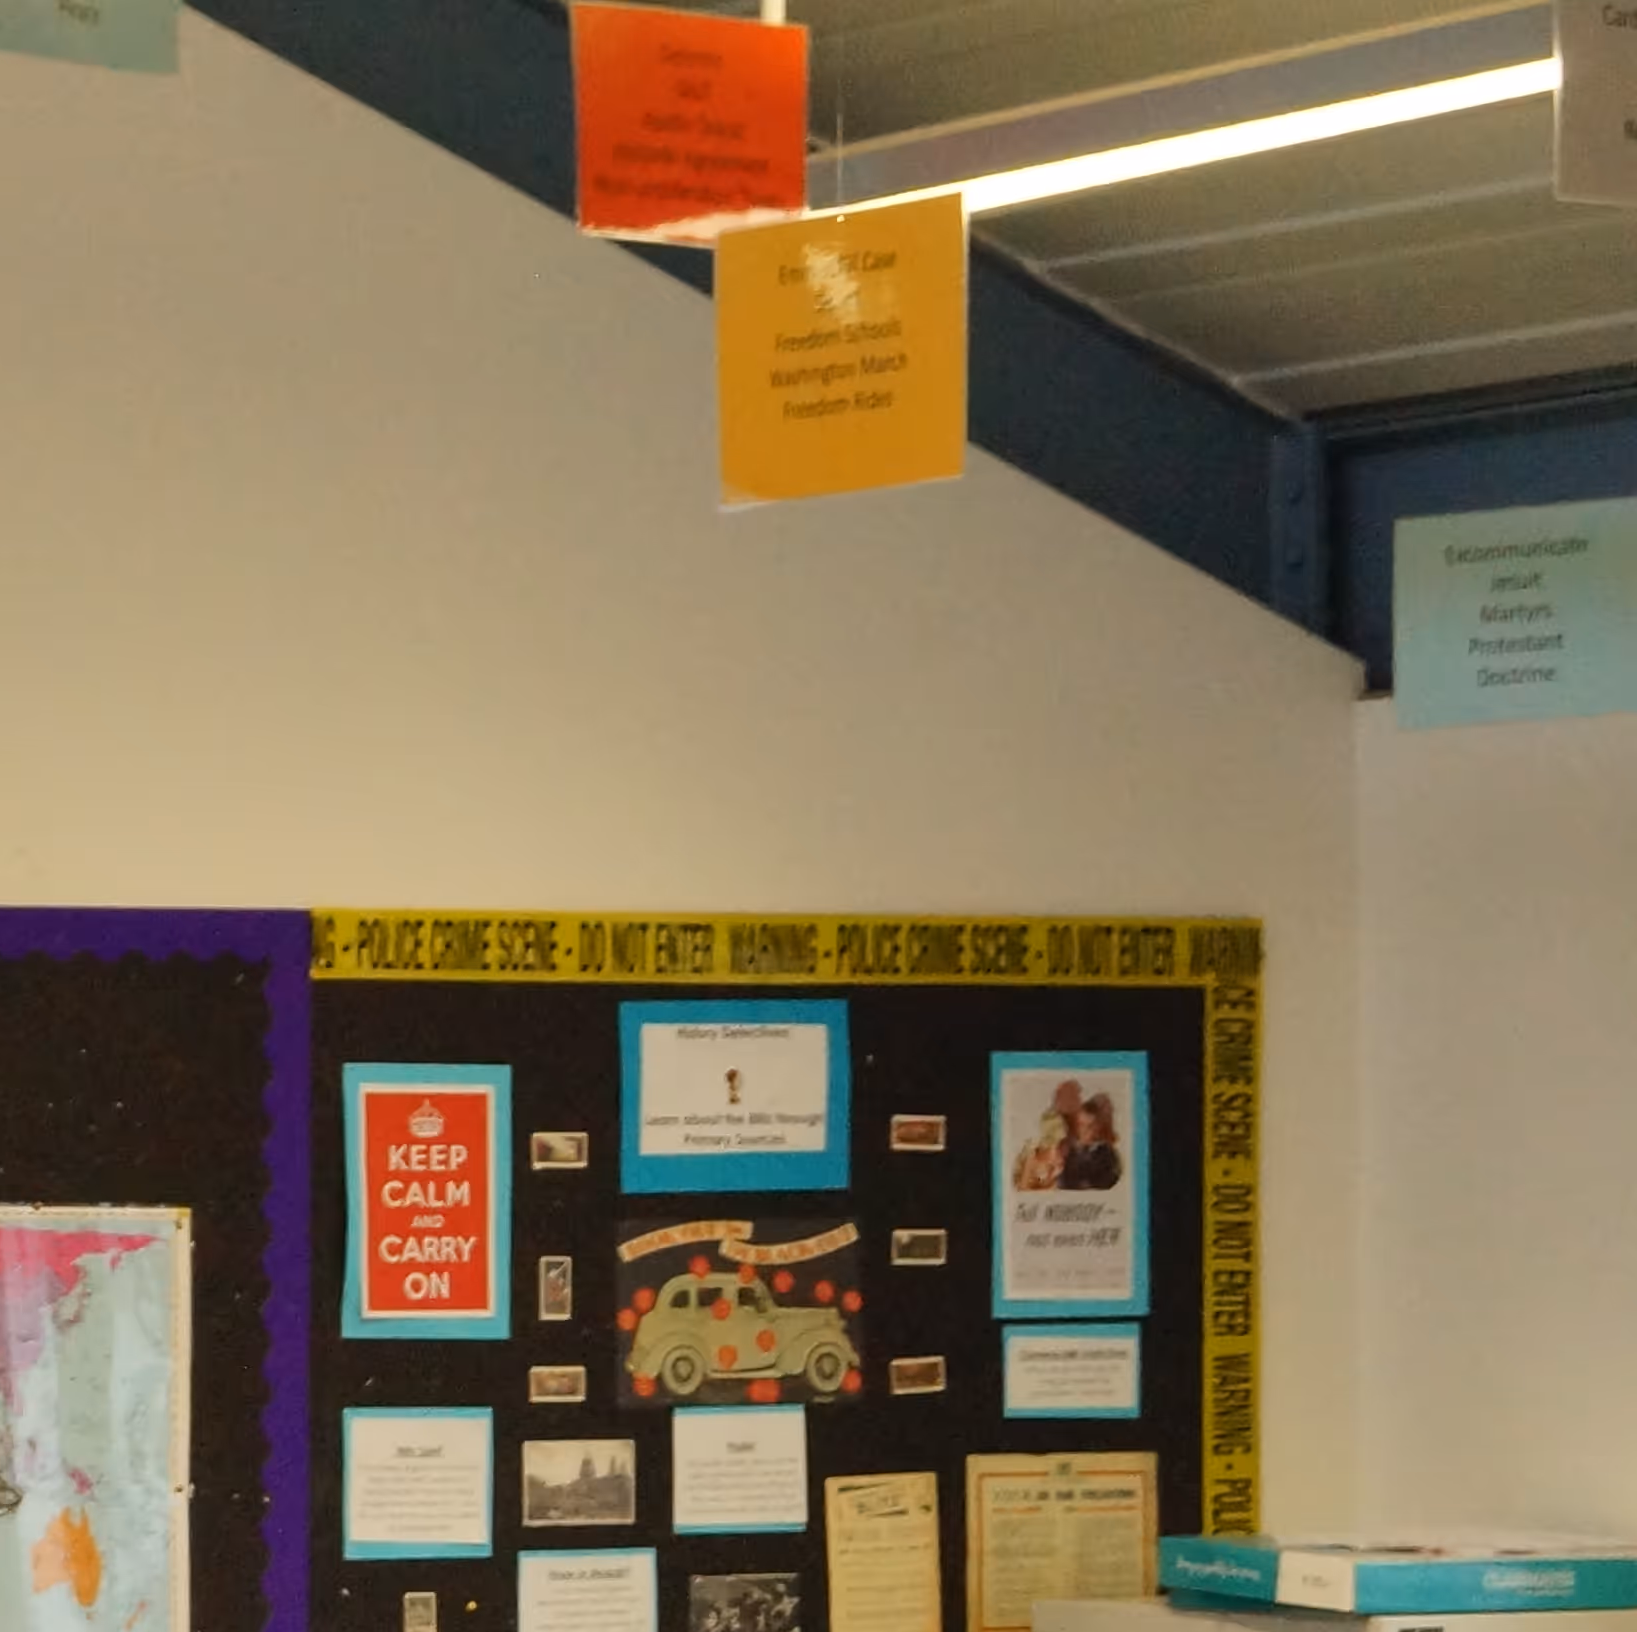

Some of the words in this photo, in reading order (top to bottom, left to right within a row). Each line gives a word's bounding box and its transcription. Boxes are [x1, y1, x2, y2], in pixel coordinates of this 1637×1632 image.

[774, 325, 841, 352] Freedom
[770, 360, 856, 389] Washington
[860, 353, 908, 376] March
[783, 394, 849, 420] Freedom
[1211, 1017, 1256, 1086] CRIME
[1211, 1092, 1256, 1160] SCENE
[387, 1143, 468, 1172] KEEP
[381, 1180, 470, 1209] CALM
[1211, 1183, 1256, 1214] DO
[410, 1213, 445, 1229] AND
[379, 1234, 477, 1265] CARRY
[1211, 1221, 1256, 1261] NOT
[403, 1271, 451, 1301] ON
[1211, 1269, 1256, 1337] ENTER
[1211, 1354, 1256, 1456] WARNING
